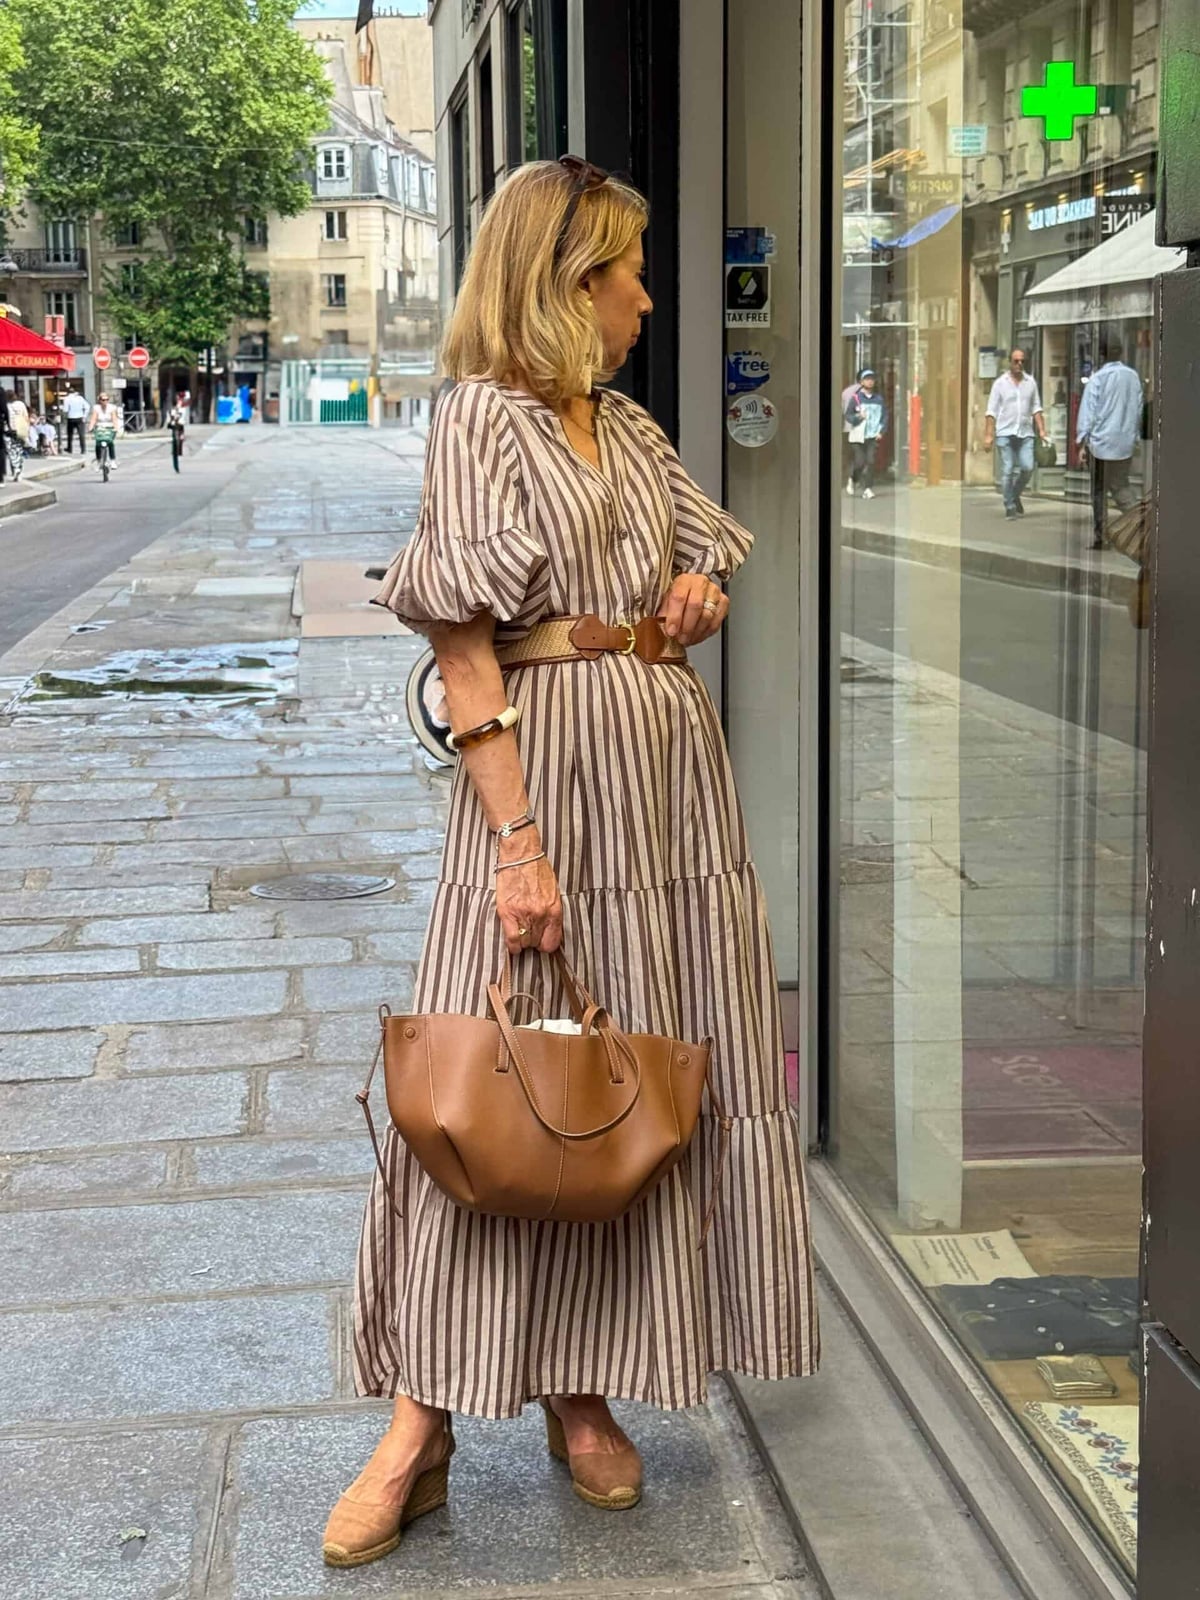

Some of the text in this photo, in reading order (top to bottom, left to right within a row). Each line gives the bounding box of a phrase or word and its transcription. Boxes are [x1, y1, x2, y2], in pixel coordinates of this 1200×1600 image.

[726, 312, 769, 322] TAX FREE
[0, 355, 58, 366] NT GERMAIN
[733, 357, 770, 372] free
